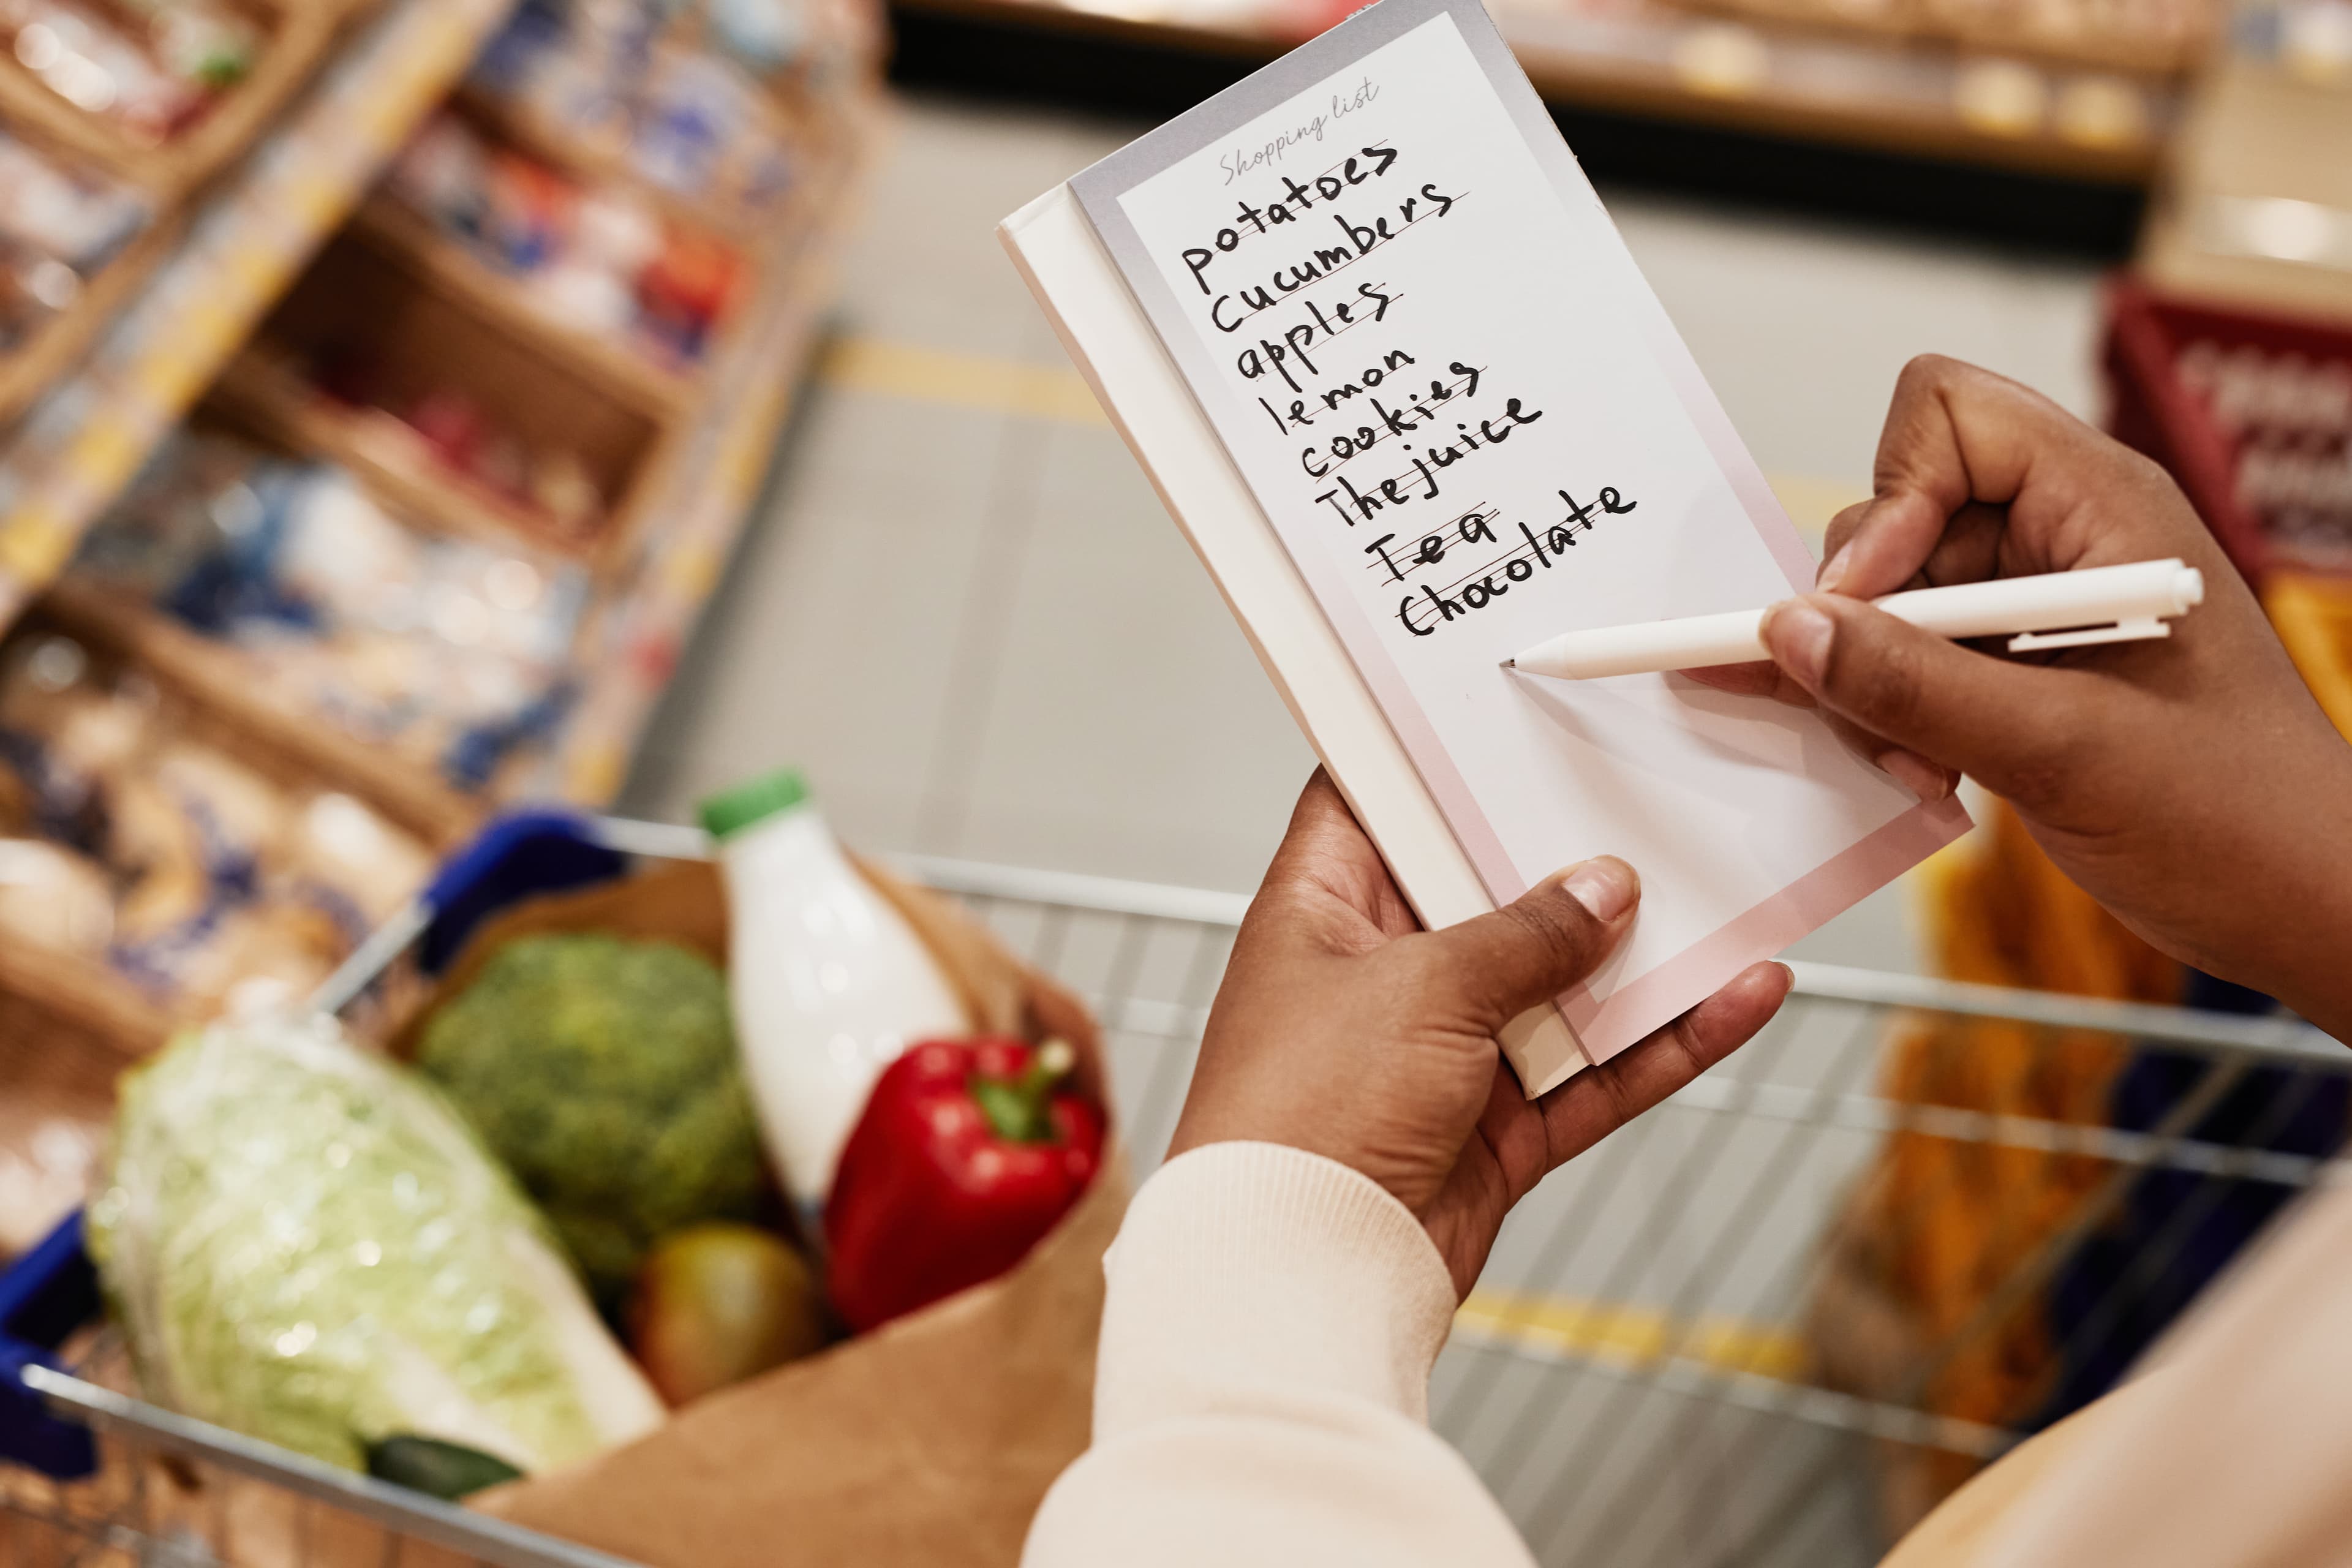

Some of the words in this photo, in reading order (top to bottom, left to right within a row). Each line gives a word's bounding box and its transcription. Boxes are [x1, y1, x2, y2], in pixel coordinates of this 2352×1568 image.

[1220, 115, 1327, 186] Shopping
[1332, 77, 1379, 118] list
[1183, 148, 1397, 295] potatoes
[1238, 282, 1389, 393] apples
[1259, 350, 1415, 435] lemon
[1302, 362, 1480, 477] cookies
[1315, 477, 1409, 527] The
[1403, 398, 1542, 500] juice
[1365, 513, 1497, 581] Tea
